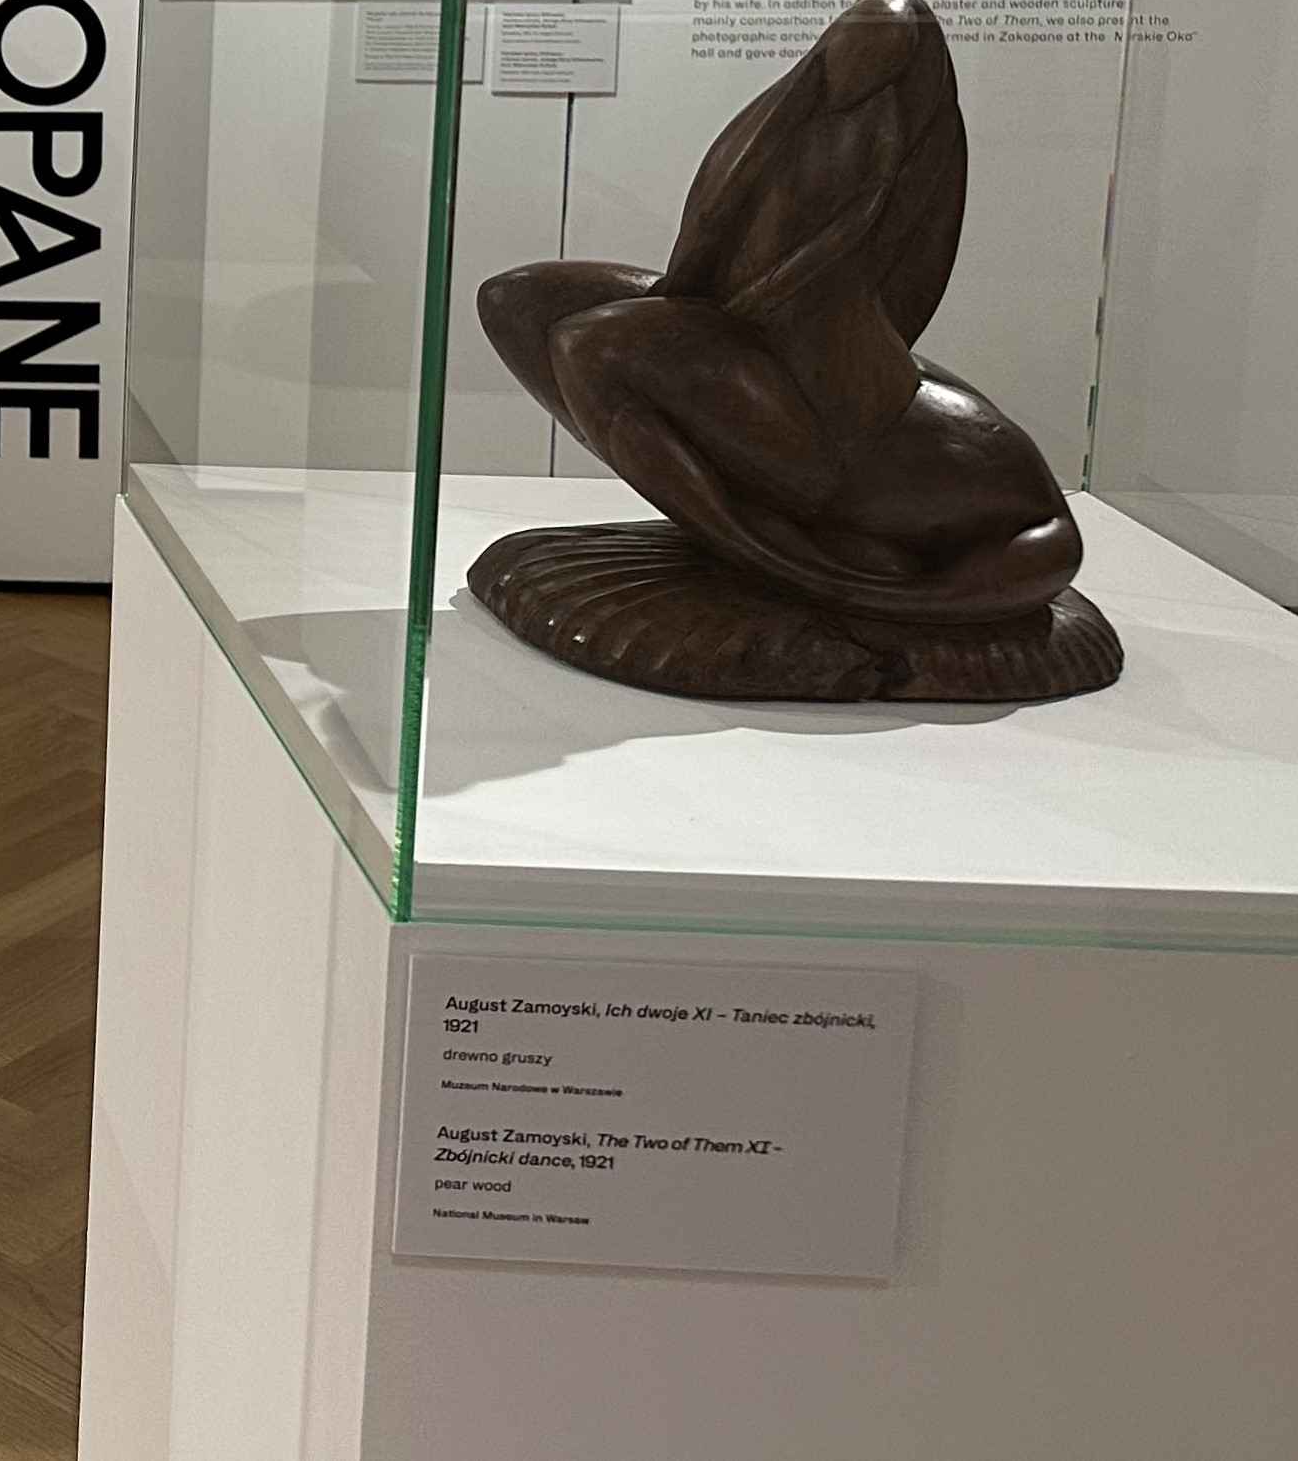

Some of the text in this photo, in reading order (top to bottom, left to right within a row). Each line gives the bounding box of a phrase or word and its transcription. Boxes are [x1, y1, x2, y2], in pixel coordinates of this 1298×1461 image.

[444, 995, 507, 1015] August
[511, 998, 600, 1019] Zamoyski,
[604, 1002, 632, 1018] Ich
[636, 1004, 689, 1022] dwoje
[691, 1006, 712, 1021] XI
[732, 1007, 789, 1024] Taniec
[442, 1018, 478, 1033] 1921
[442, 1048, 553, 1067] drewno gruszy
[440, 1079, 489, 1091] Muzeum
[436, 1125, 498, 1144] August
[501, 1127, 591, 1149] Zamoyski,
[597, 1132, 629, 1148] The
[633, 1134, 668, 1150] Two
[670, 1136, 691, 1151] of
[693, 1137, 743, 1153] Them
[744, 1139, 773, 1155] XI
[433, 1147, 614, 1170] Zbójnicki dance, 1921
[434, 1179, 512, 1192] pear wood
[432, 1208, 479, 1219] National
[481, 1210, 530, 1222] Museum
[545, 1214, 590, 1225] Warsaw
